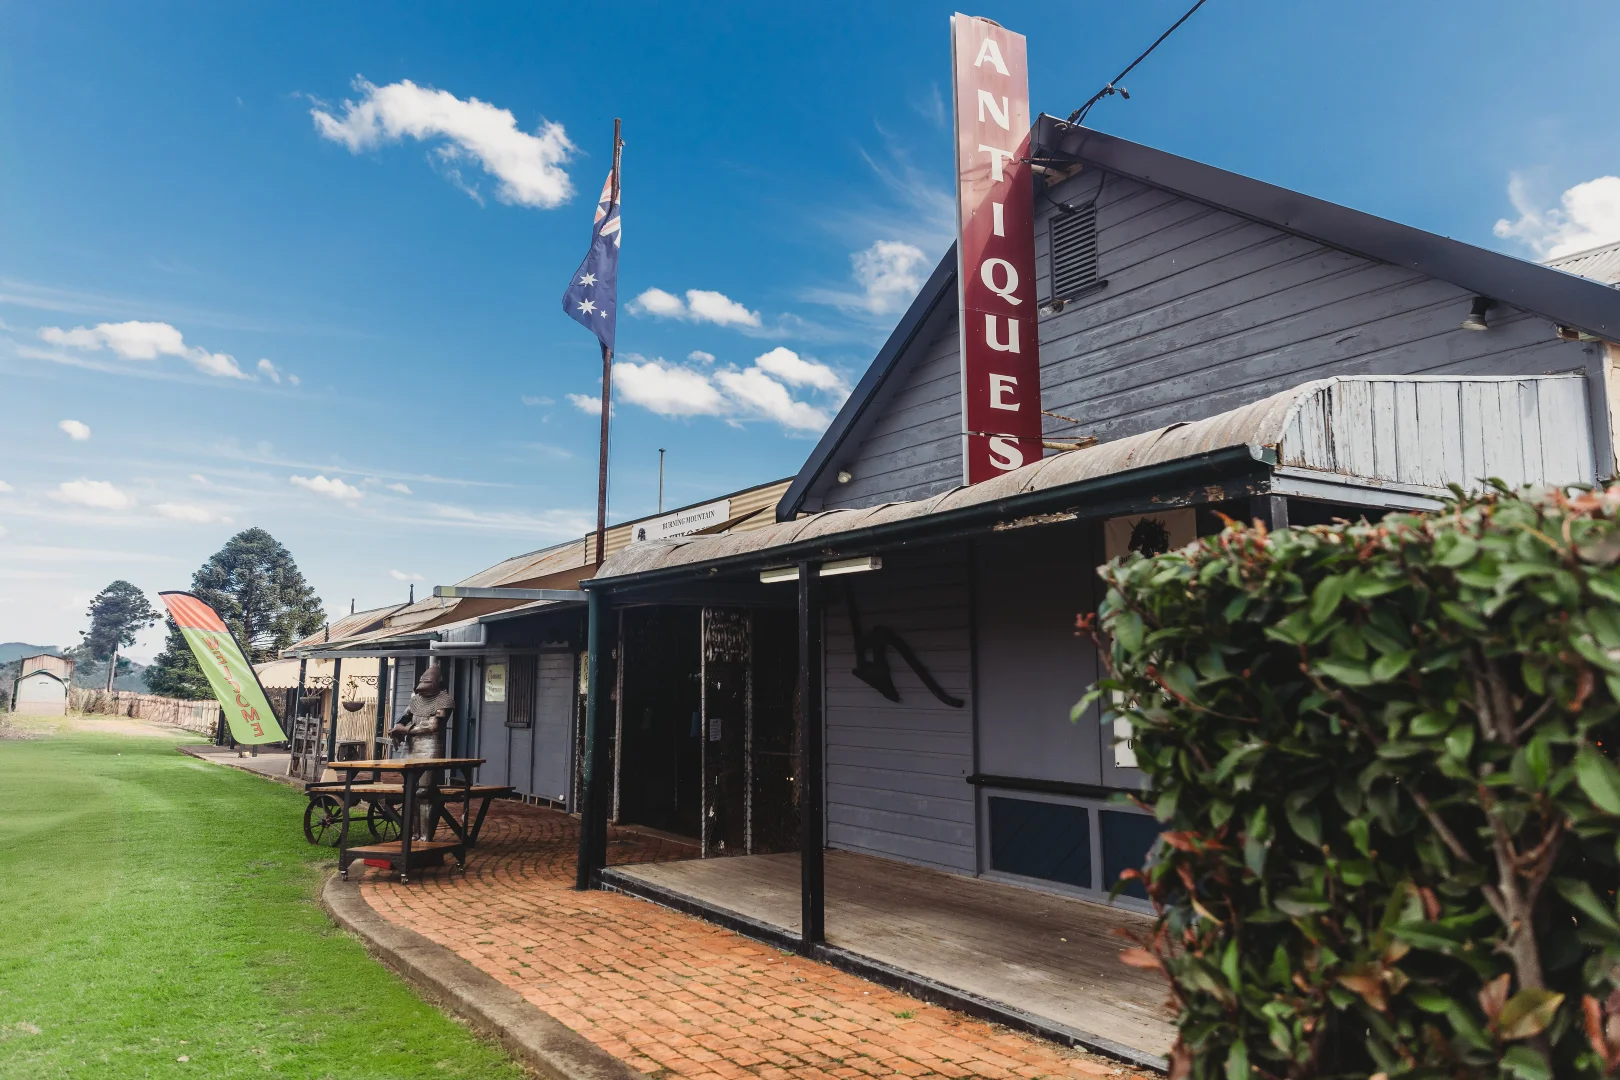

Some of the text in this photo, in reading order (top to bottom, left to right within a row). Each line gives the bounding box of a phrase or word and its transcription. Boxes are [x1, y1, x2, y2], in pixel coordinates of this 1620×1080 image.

[973, 37, 1024, 471] ANTIQUES
[662, 510, 715, 530] BURNING MOUNTAIN
